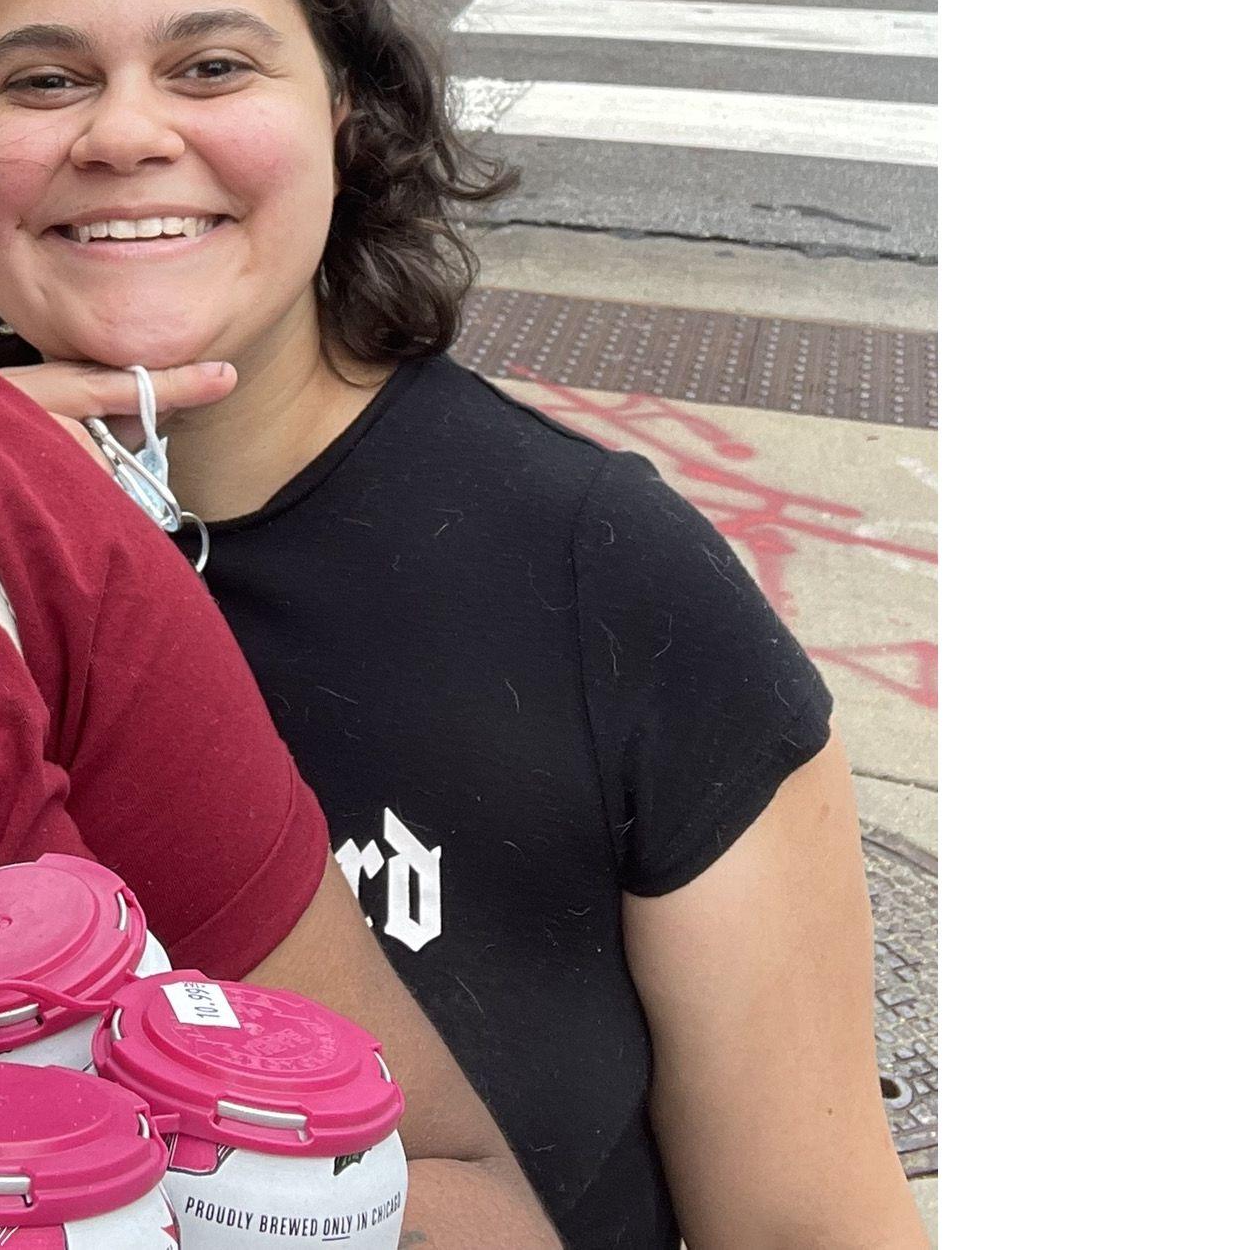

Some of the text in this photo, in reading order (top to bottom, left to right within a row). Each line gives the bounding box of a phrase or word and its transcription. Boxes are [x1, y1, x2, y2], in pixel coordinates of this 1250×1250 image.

[185, 988, 220, 1018] 10.99
[185, 1196, 254, 1230] PROUDLY
[259, 1214, 318, 1237] BREWED
[323, 1216, 353, 1236] ONLY
[357, 1211, 368, 1231] IN
